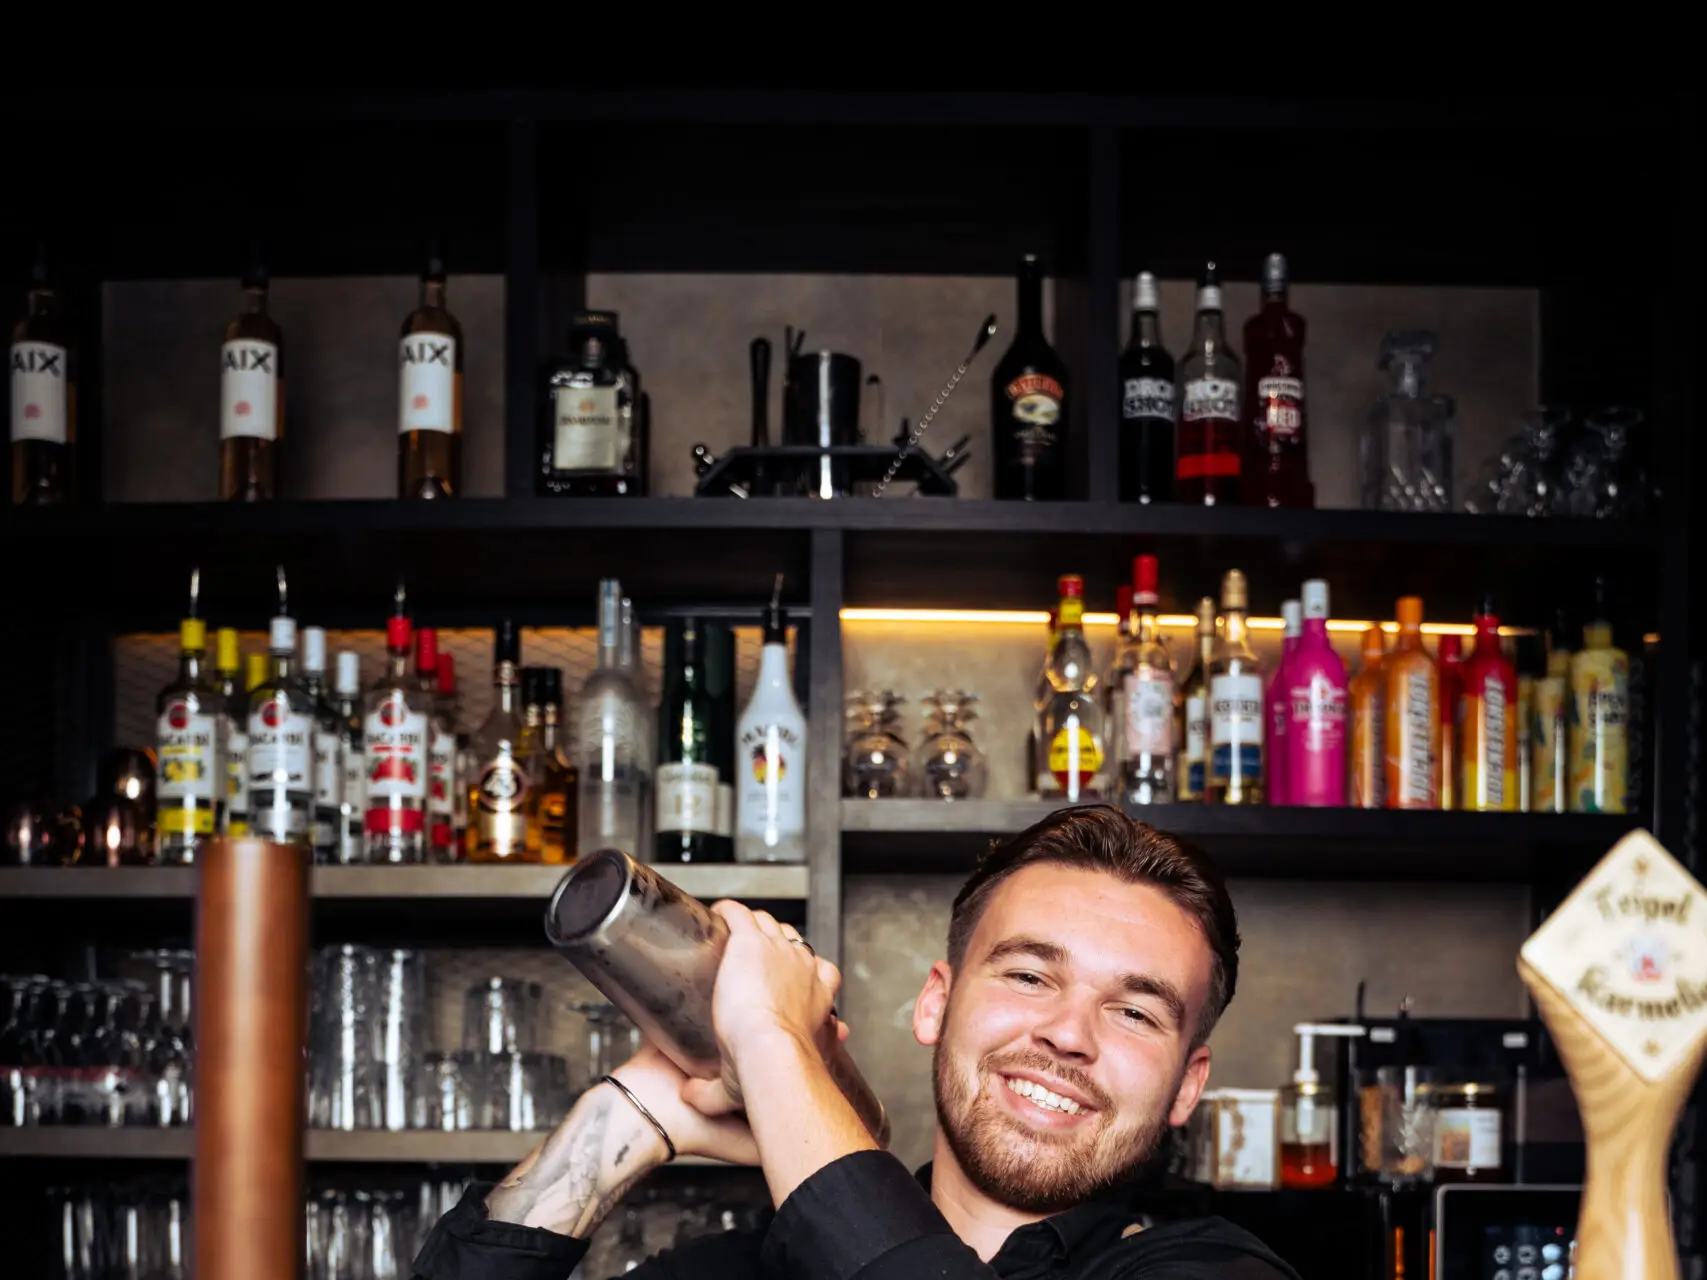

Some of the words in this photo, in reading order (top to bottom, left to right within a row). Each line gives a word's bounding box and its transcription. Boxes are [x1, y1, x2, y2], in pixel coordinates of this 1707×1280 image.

[11, 348, 61, 377] AIX
[222, 348, 272, 373] AIX
[402, 342, 449, 366] AIX
